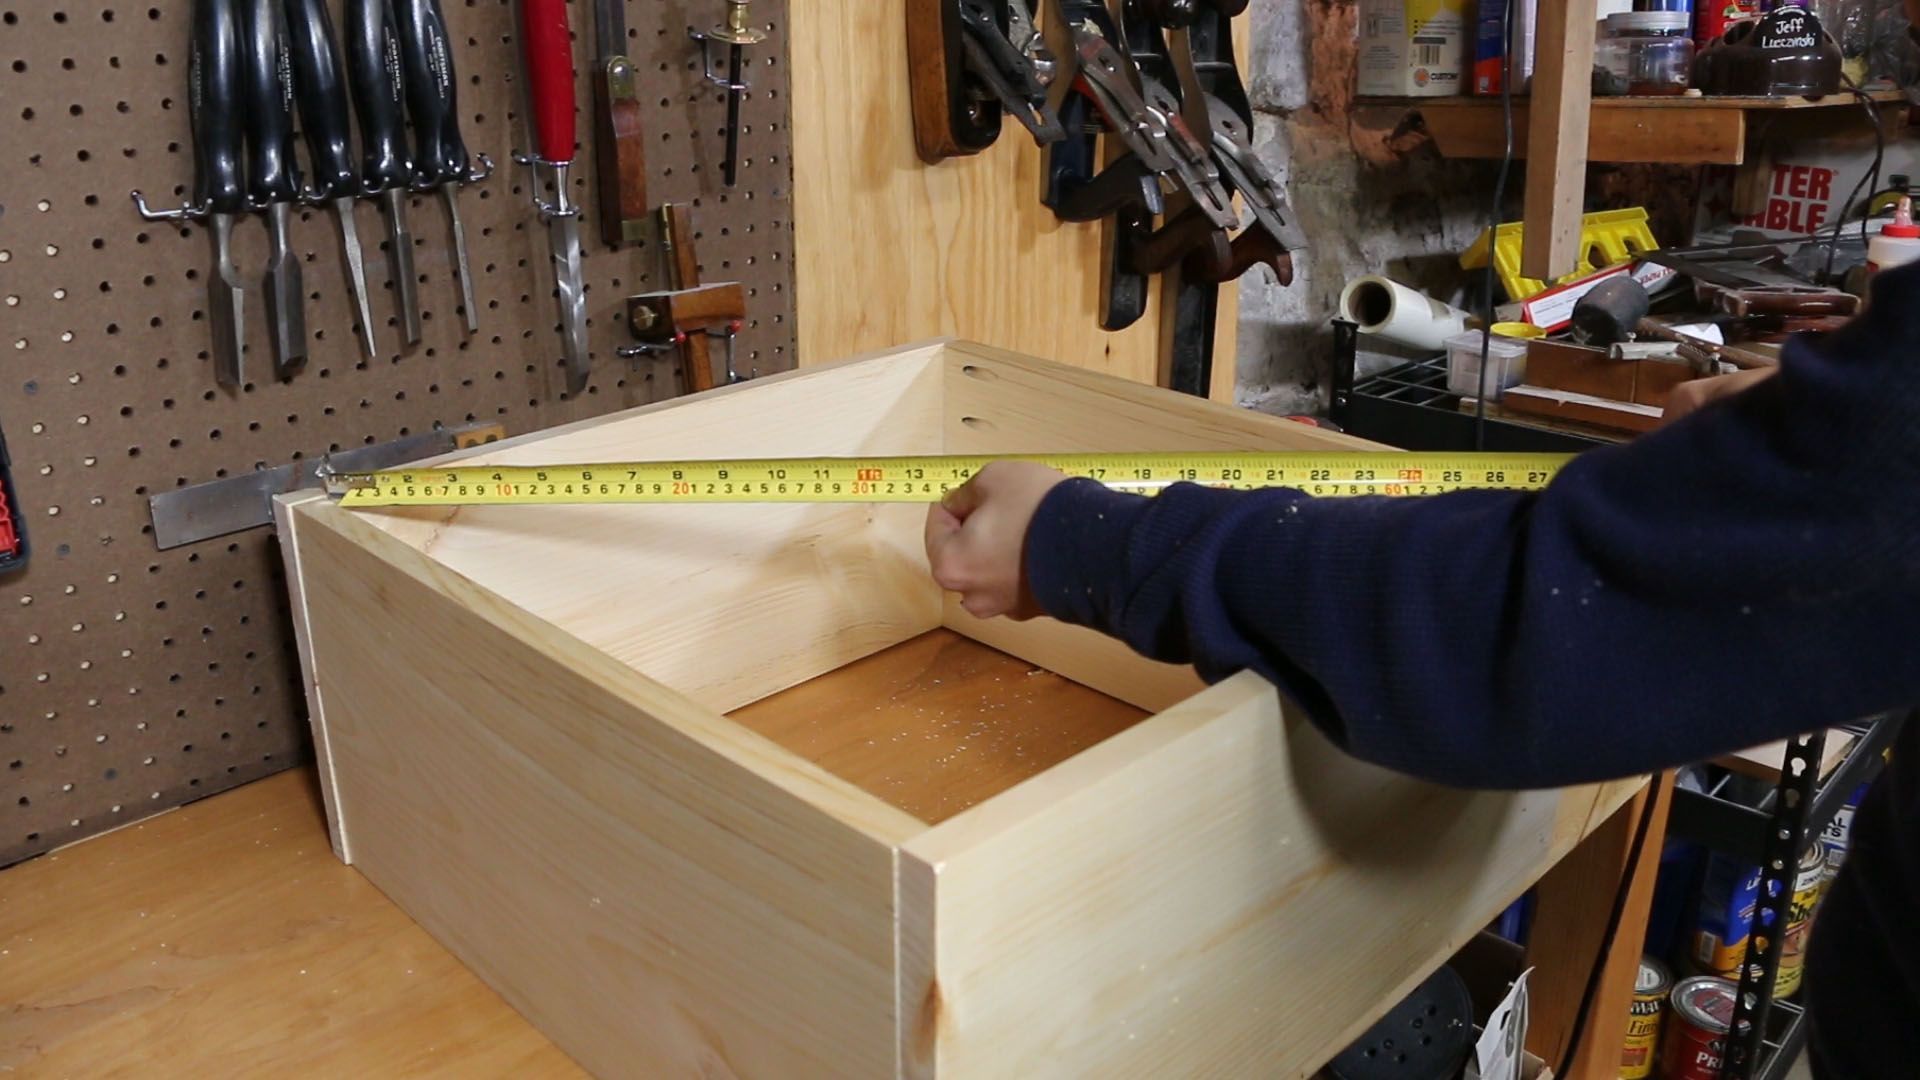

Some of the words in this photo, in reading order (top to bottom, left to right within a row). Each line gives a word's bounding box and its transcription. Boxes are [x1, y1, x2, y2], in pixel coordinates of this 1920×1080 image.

[1776, 18, 1804, 34] Jeff
[1774, 164, 1832, 201] TER
[448, 474, 457, 482] 3
[537, 472, 547, 481] 5
[582, 471, 592, 480] 6
[627, 471, 637, 480] 7
[672, 470, 682, 480] 8
[718, 470, 728, 479] 9
[768, 470, 786, 479] 10
[814, 470, 830, 479] 11
[905, 469, 924, 479] 13
[1088, 469, 1106, 479] 17
[1133, 469, 1151, 479] 18
[1178, 469, 1196, 480] 19
[1222, 469, 1242, 480] 20
[1267, 470, 1284, 480] 21
[1311, 470, 1330, 480] 22
[1355, 470, 1374, 480] 23
[1443, 471, 1462, 482] 25
[1486, 472, 1504, 482] 26
[1528, 472, 1547, 482] 27
[356, 488, 362, 496] 2
[374, 488, 380, 496] 3
[390, 487, 397, 496] 4
[407, 487, 415, 496] 5
[424, 486, 432, 496] 6
[442, 486, 448, 495] 7
[459, 486, 467, 495] 8
[476, 486, 484, 495] 9
[496, 484, 512, 495] 10
[514, 485, 519, 494] 1
[530, 485, 537, 494] 2
[547, 485, 555, 494] 3
[565, 485, 572, 494] 4
[582, 485, 590, 494] 5
[600, 485, 608, 494] 6
[618, 484, 625, 494] 7
[635, 484, 643, 494] 8
[653, 484, 661, 494] 9
[672, 483, 689, 494] 20
[691, 484, 696, 493] 1
[707, 484, 715, 493] 2
[725, 484, 732, 493] 3
[742, 484, 750, 493] 4
[760, 484, 768, 493] 5
[778, 483, 786, 493] 6
[796, 483, 803, 493] 7
[814, 483, 822, 493] 8
[832, 483, 840, 493] 9
[852, 482, 869, 494] 30
[871, 483, 876, 492] 1
[886, 483, 894, 493] 2
[904, 483, 912, 493] 3
[922, 483, 930, 493] 4
[940, 483, 949, 493] 5
[1314, 485, 1322, 494] 6
[1332, 485, 1339, 494] 7
[1350, 485, 1357, 494] 8
[1367, 485, 1375, 494] 9
[1385, 484, 1401, 494] 60
[1404, 486, 1410, 495] 1
[1420, 486, 1428, 495] 2
